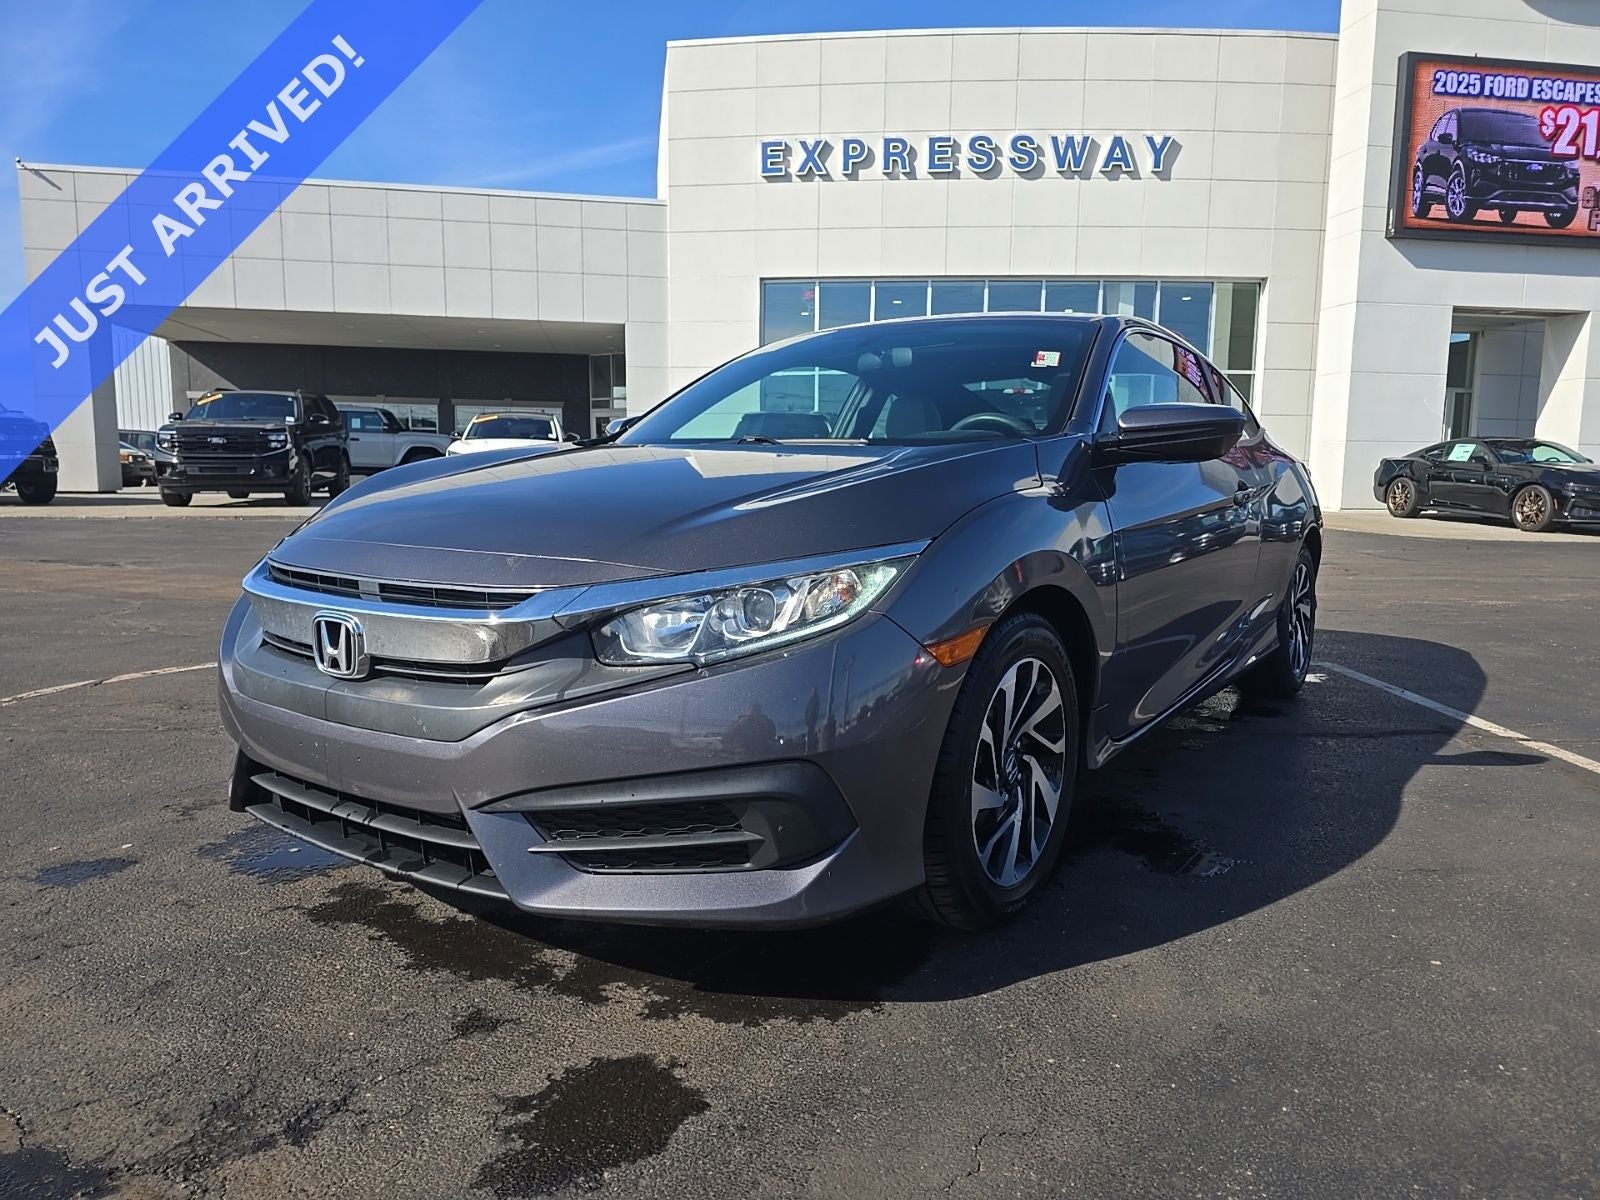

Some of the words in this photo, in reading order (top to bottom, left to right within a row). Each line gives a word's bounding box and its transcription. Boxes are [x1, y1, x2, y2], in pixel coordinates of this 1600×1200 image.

[1434, 71, 1481, 95] 2025
[1483, 75, 1529, 98] FORD
[760, 133, 1177, 179] EXPRESSWAY
